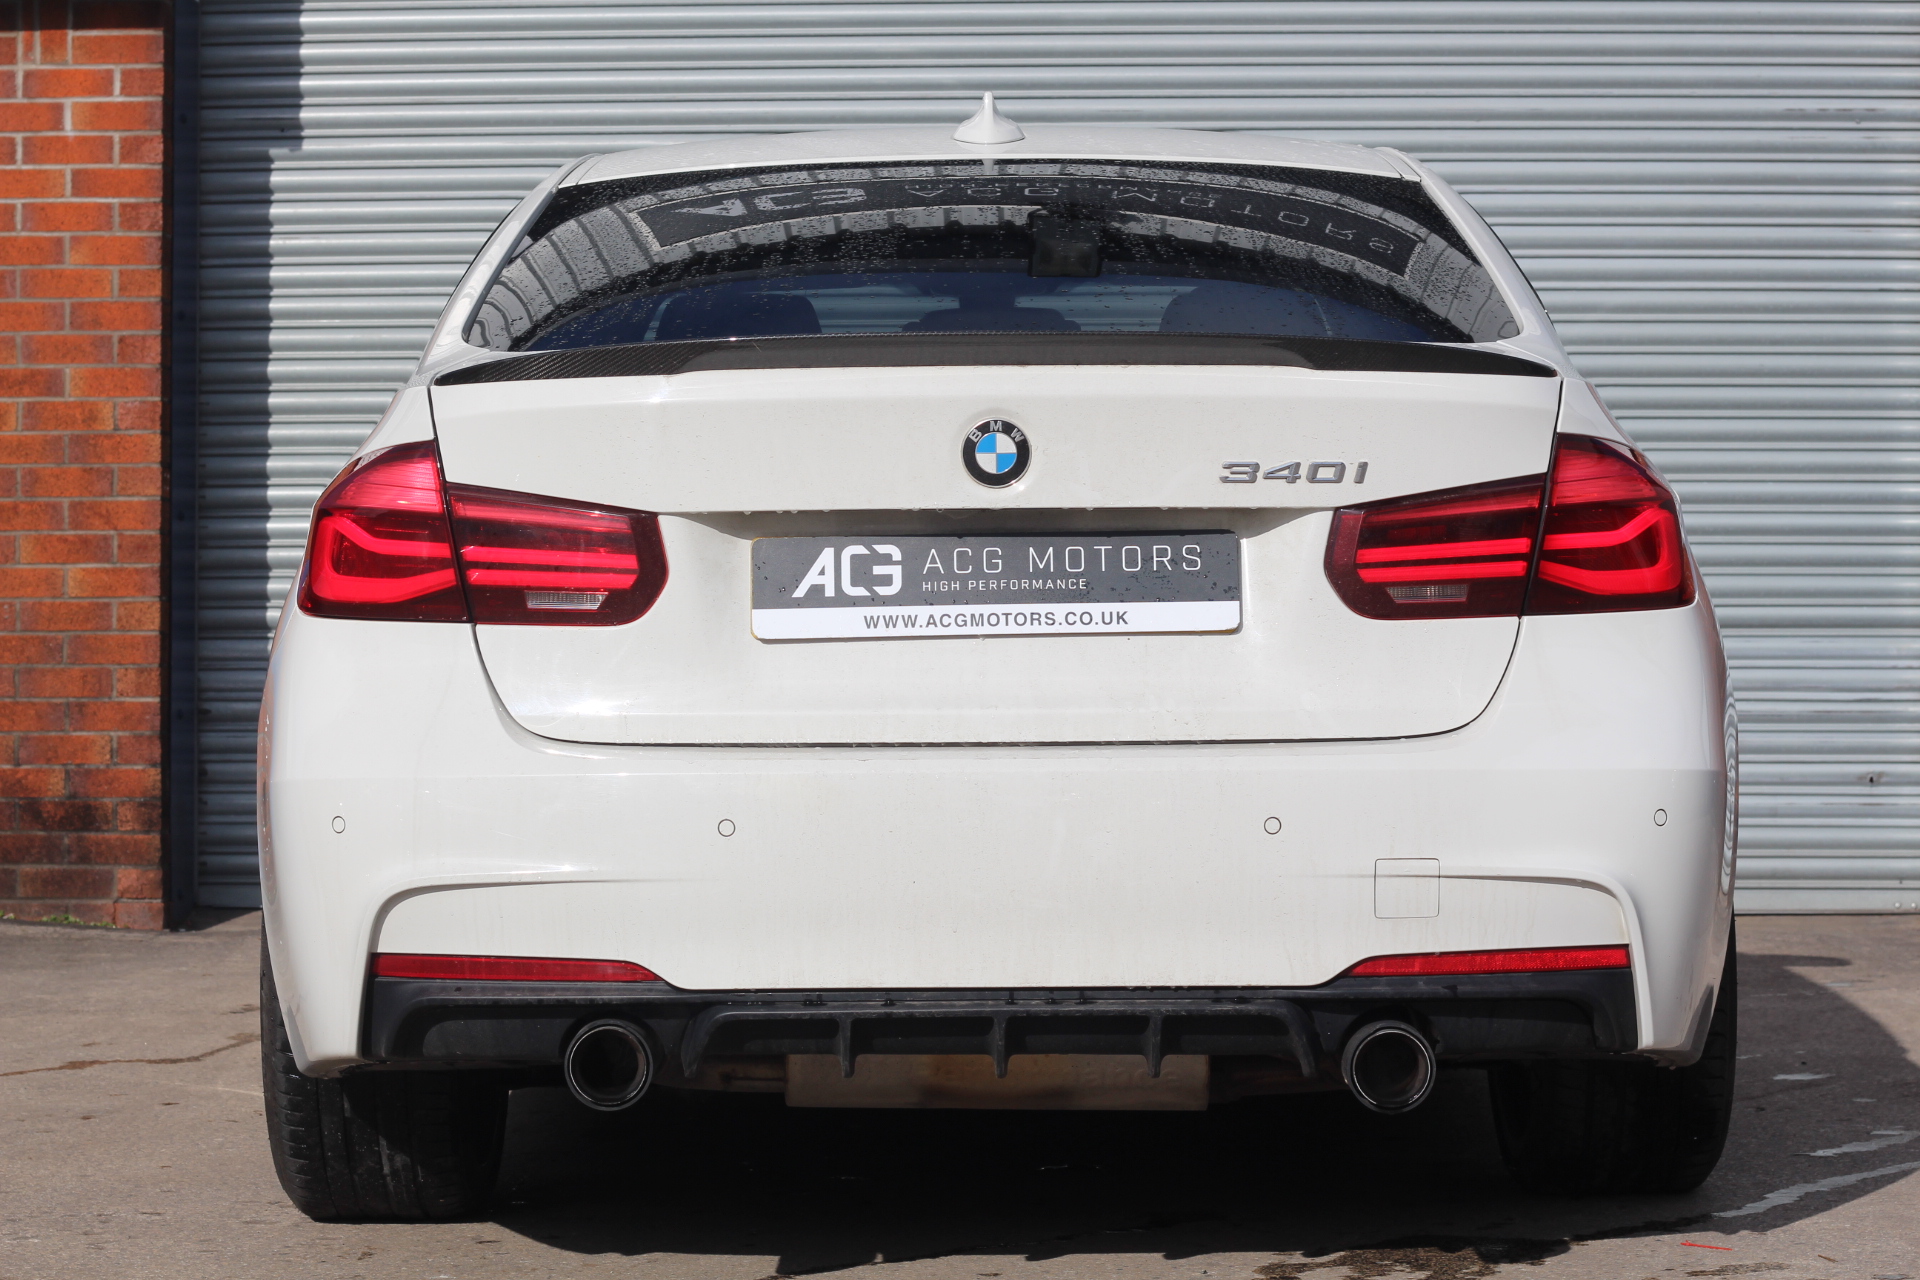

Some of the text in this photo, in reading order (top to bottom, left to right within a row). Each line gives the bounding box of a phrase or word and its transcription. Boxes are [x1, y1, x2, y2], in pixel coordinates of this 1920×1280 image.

[968, 420, 1025, 443] BMW
[791, 544, 902, 598] ACG
[922, 544, 1201, 575] ACG MOTORS
[922, 578, 1087, 592] HIGH PERFORMANCE
[863, 610, 1129, 629] WWW.ACGMOTORS.CO.UK
